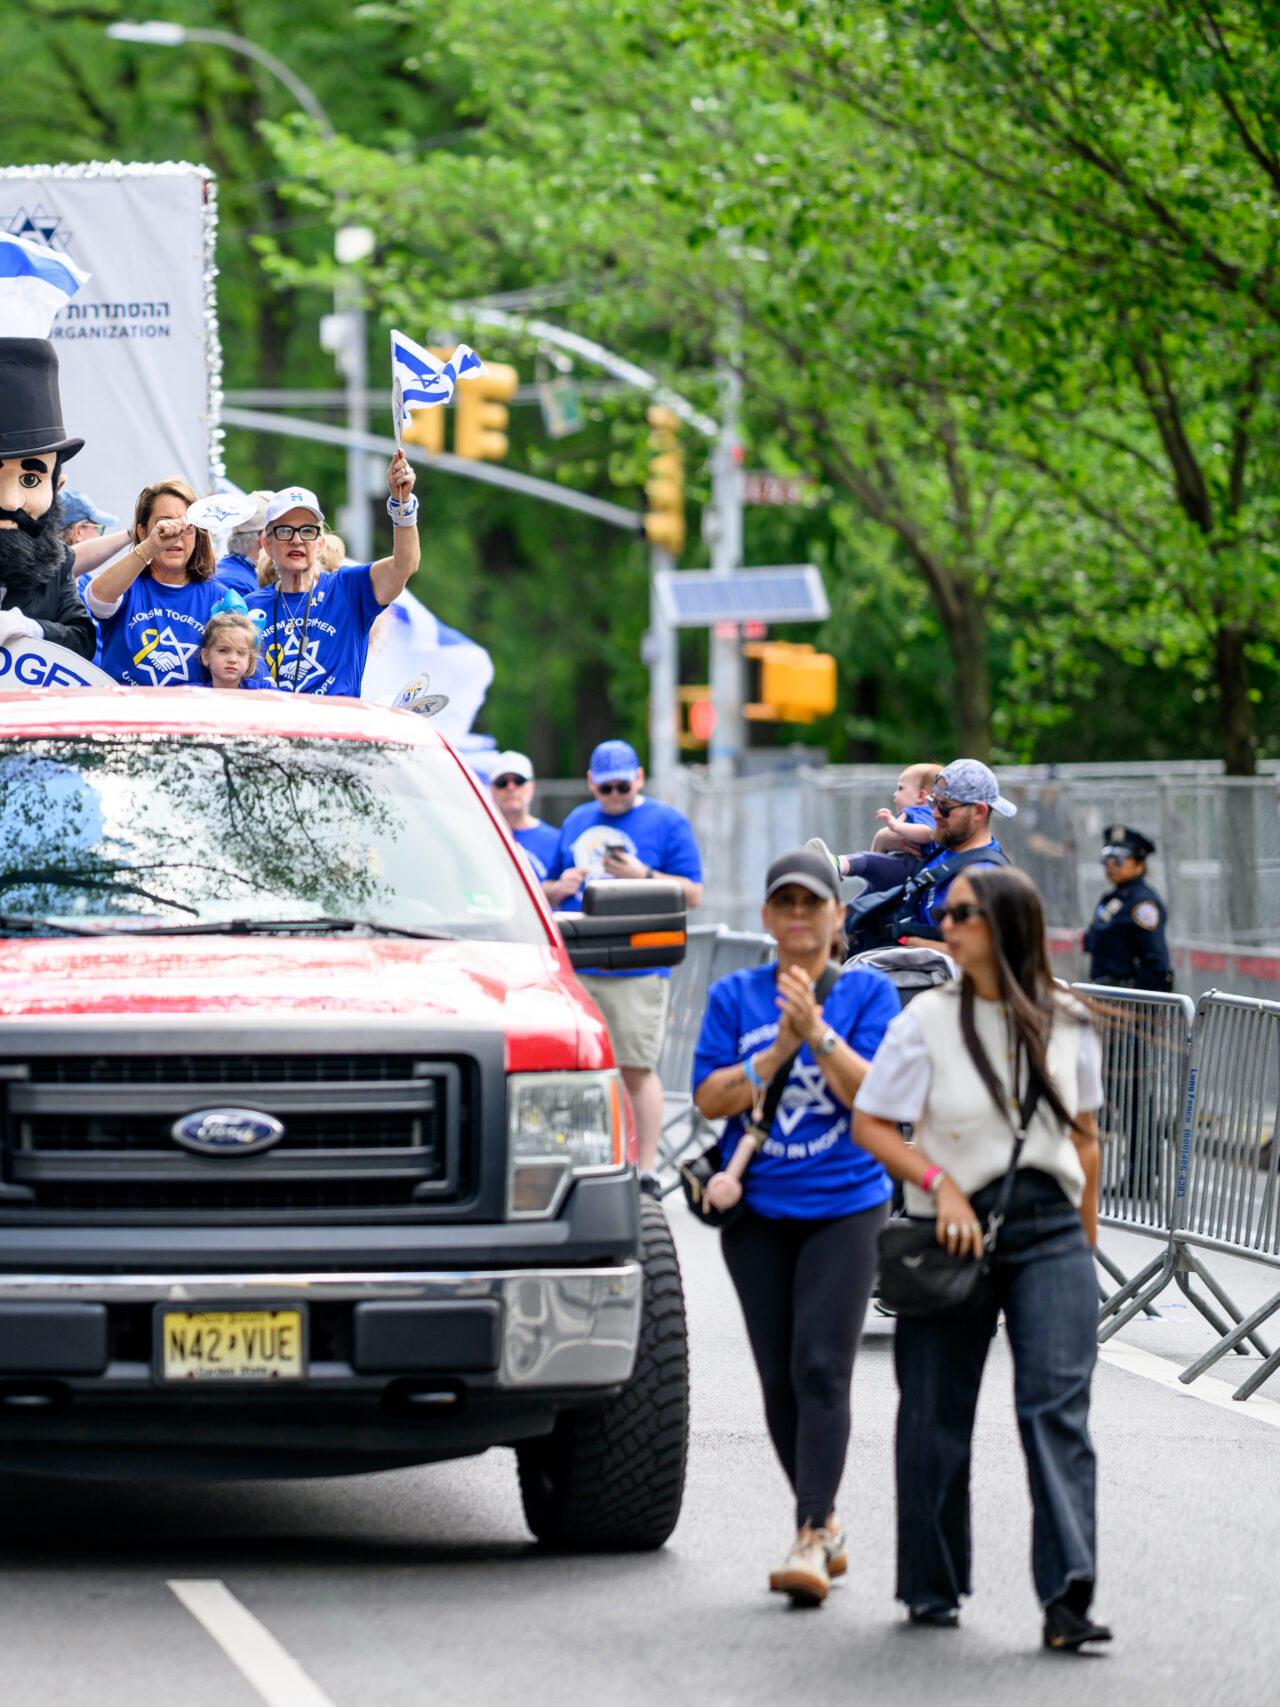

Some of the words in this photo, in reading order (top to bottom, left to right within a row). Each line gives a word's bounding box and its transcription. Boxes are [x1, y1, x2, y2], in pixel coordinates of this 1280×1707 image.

[67, 302, 170, 319] ההסתדרות
[165, 609, 206, 635] TOGETH
[261, 620, 286, 640] NISM
[1187, 1069, 1199, 1092] Long
[1185, 1094, 1196, 1123] Fence
[197, 1114, 256, 1144] Ford
[170, 1327, 223, 1362] N42
